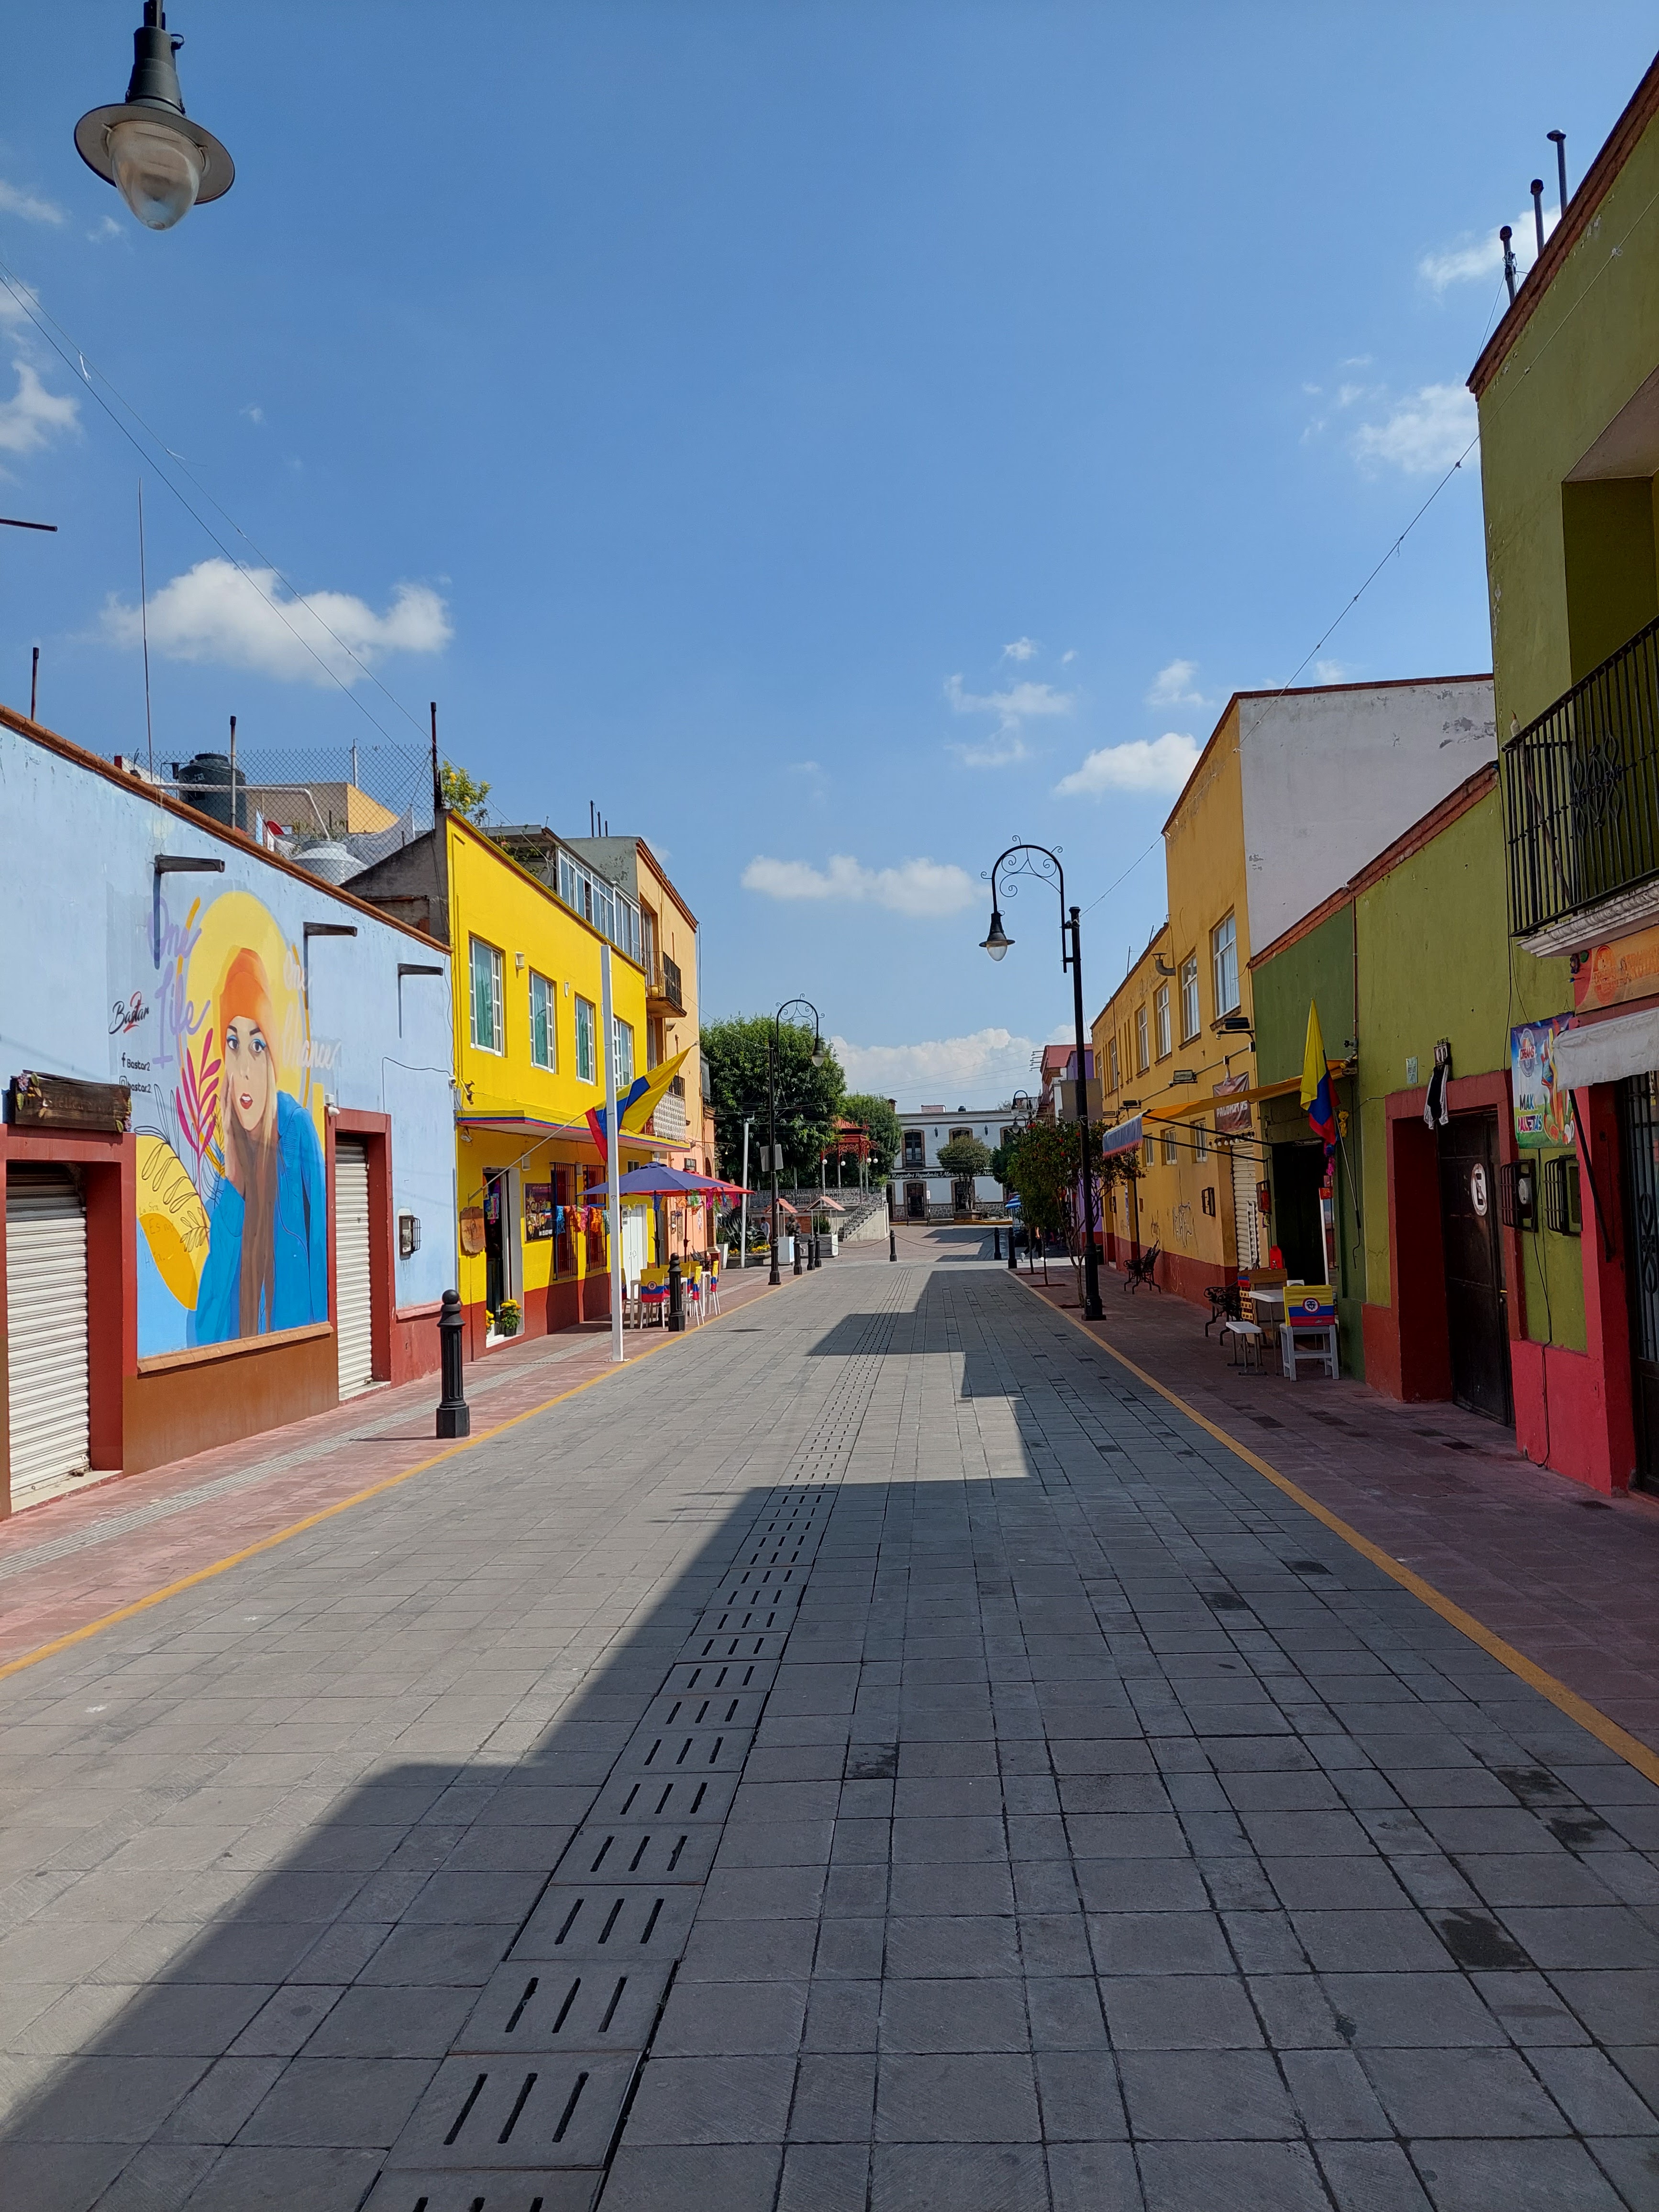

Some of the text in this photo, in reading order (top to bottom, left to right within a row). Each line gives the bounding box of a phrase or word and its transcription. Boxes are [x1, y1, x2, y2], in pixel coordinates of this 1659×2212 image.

[127, 1058, 150, 1071] Bastar2
[1217, 1100, 1248, 1117] PALOMITAS
[1520, 1094, 1534, 1110] MAX
[1518, 1115, 1542, 1131] PALETAS
